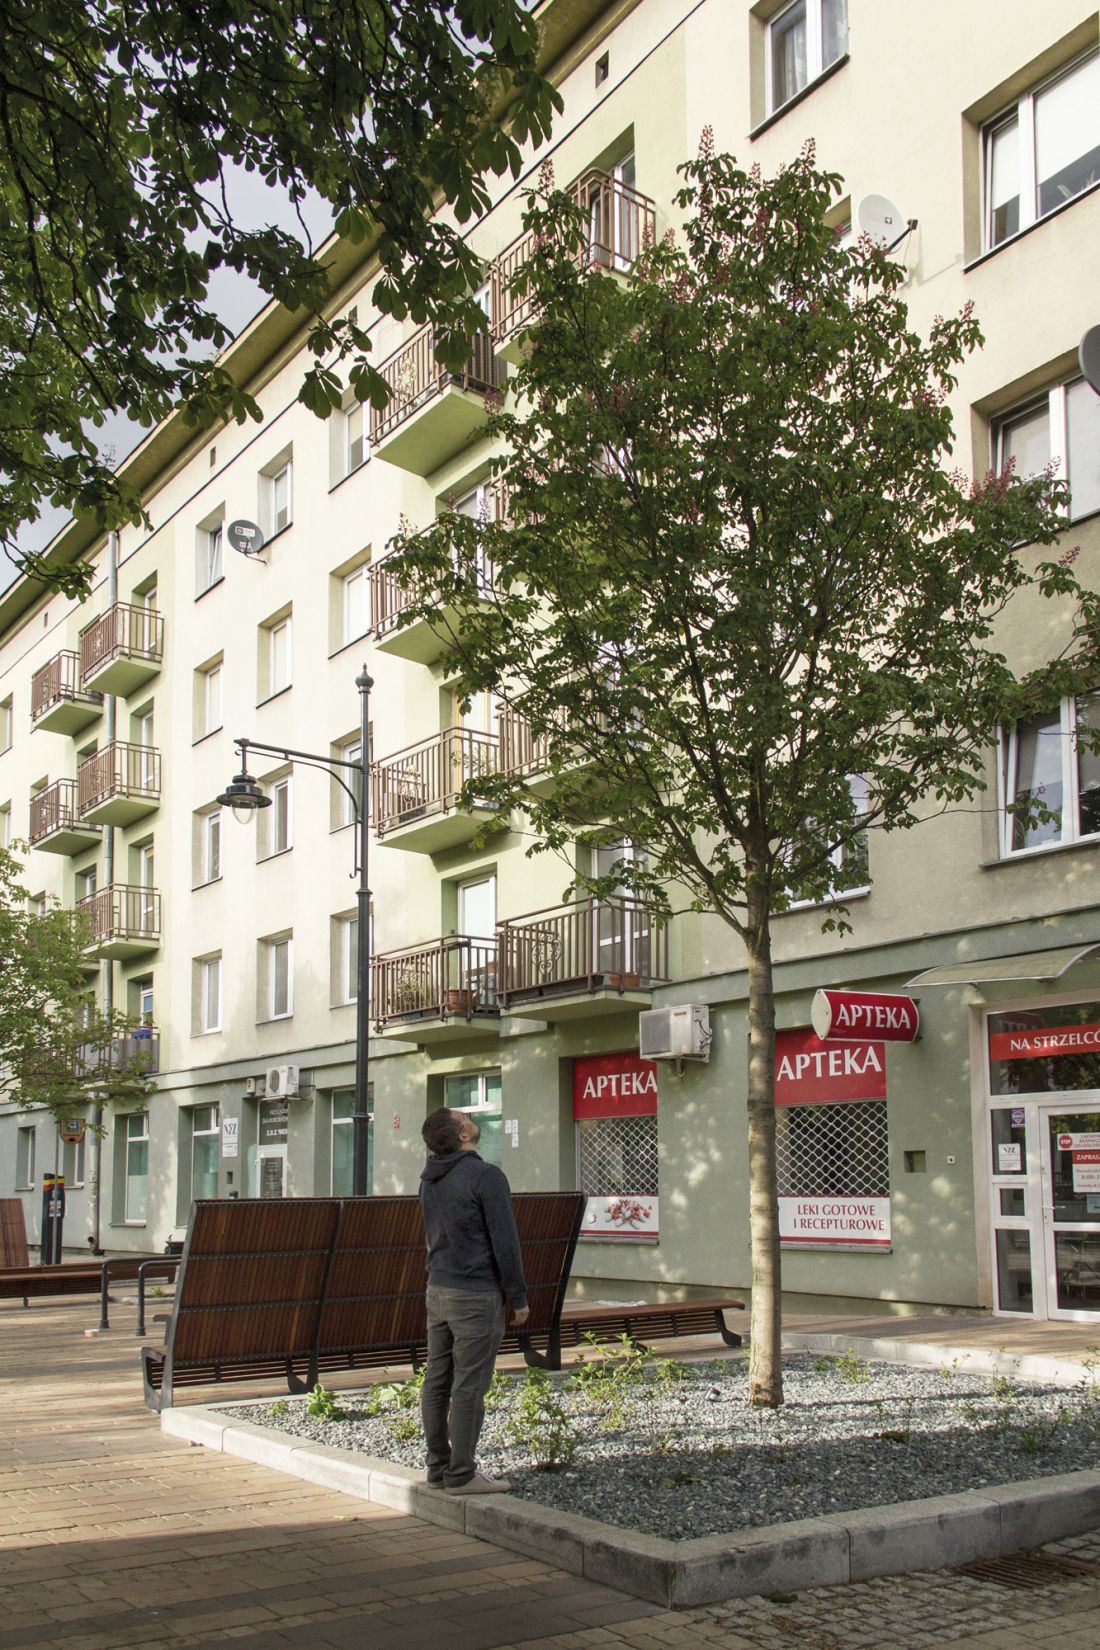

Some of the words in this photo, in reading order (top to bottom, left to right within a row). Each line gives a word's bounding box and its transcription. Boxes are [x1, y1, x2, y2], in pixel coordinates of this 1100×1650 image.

[835, 1003, 911, 1029] APTEKA
[1010, 1038, 1030, 1051] NA
[776, 1045, 883, 1082] APTEKA
[582, 1069, 658, 1099] APTEKA
[797, 1204, 819, 1215] LEKI
[822, 1204, 876, 1216] GOTOWE
[793, 1218, 797, 1229] I
[800, 1218, 886, 1231] RECEPTUROWE
